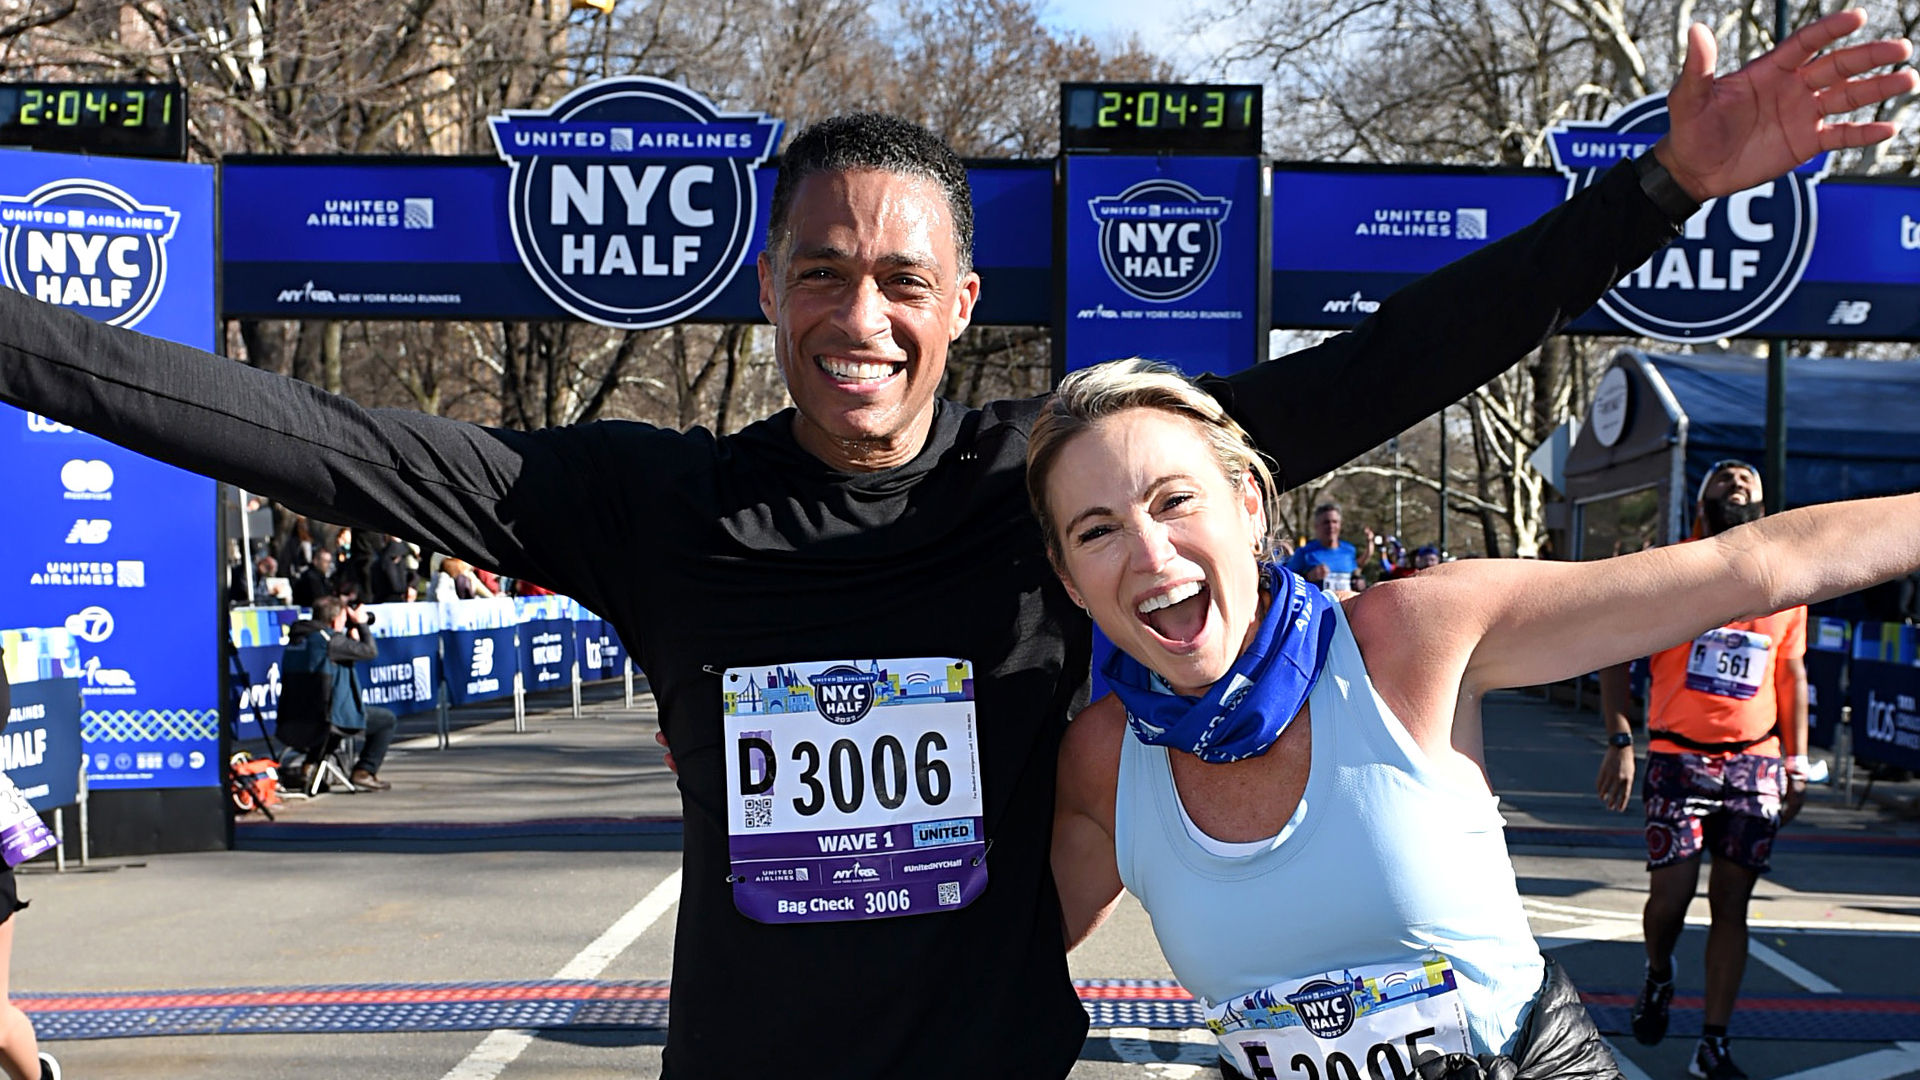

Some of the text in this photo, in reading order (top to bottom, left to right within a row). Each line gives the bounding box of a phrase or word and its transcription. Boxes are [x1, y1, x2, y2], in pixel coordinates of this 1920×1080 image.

[514, 131, 753, 148] UNITED AIRLINES
[1572, 142, 1655, 159] UNITE
[551, 164, 714, 227] NYC
[325, 200, 399, 213] UNITED
[1101, 206, 1220, 216] UNITED AIRLINES
[1374, 210, 1451, 223] UNITED
[2, 208, 164, 231] UNITED AIRLINES
[306, 213, 399, 227] AIRLINES
[1119, 223, 1201, 254] NYC
[1355, 223, 1451, 237] AIRLINES
[27, 230, 141, 278] NYC
[562, 234, 701, 275] HALF
[1124, 257, 1195, 277] HALF
[36, 275, 132, 308] HALF
[46, 562, 114, 573] UNITED
[30, 573, 114, 585] AIRLINES
[370, 664, 412, 684] UNITED
[1717, 652, 1750, 679] 561
[362, 684, 413, 704] AIRLINES
[822, 684, 866, 702] NYC
[826, 701, 863, 714] HALF
[738, 731, 952, 816] D 3006
[818, 831, 895, 852] WAVE 1
[919, 822, 969, 841] UNITED
[777, 889, 911, 915] Bag Check 3006
[1302, 997, 1346, 1018] NYC
[1311, 1014, 1345, 1030] HALF
